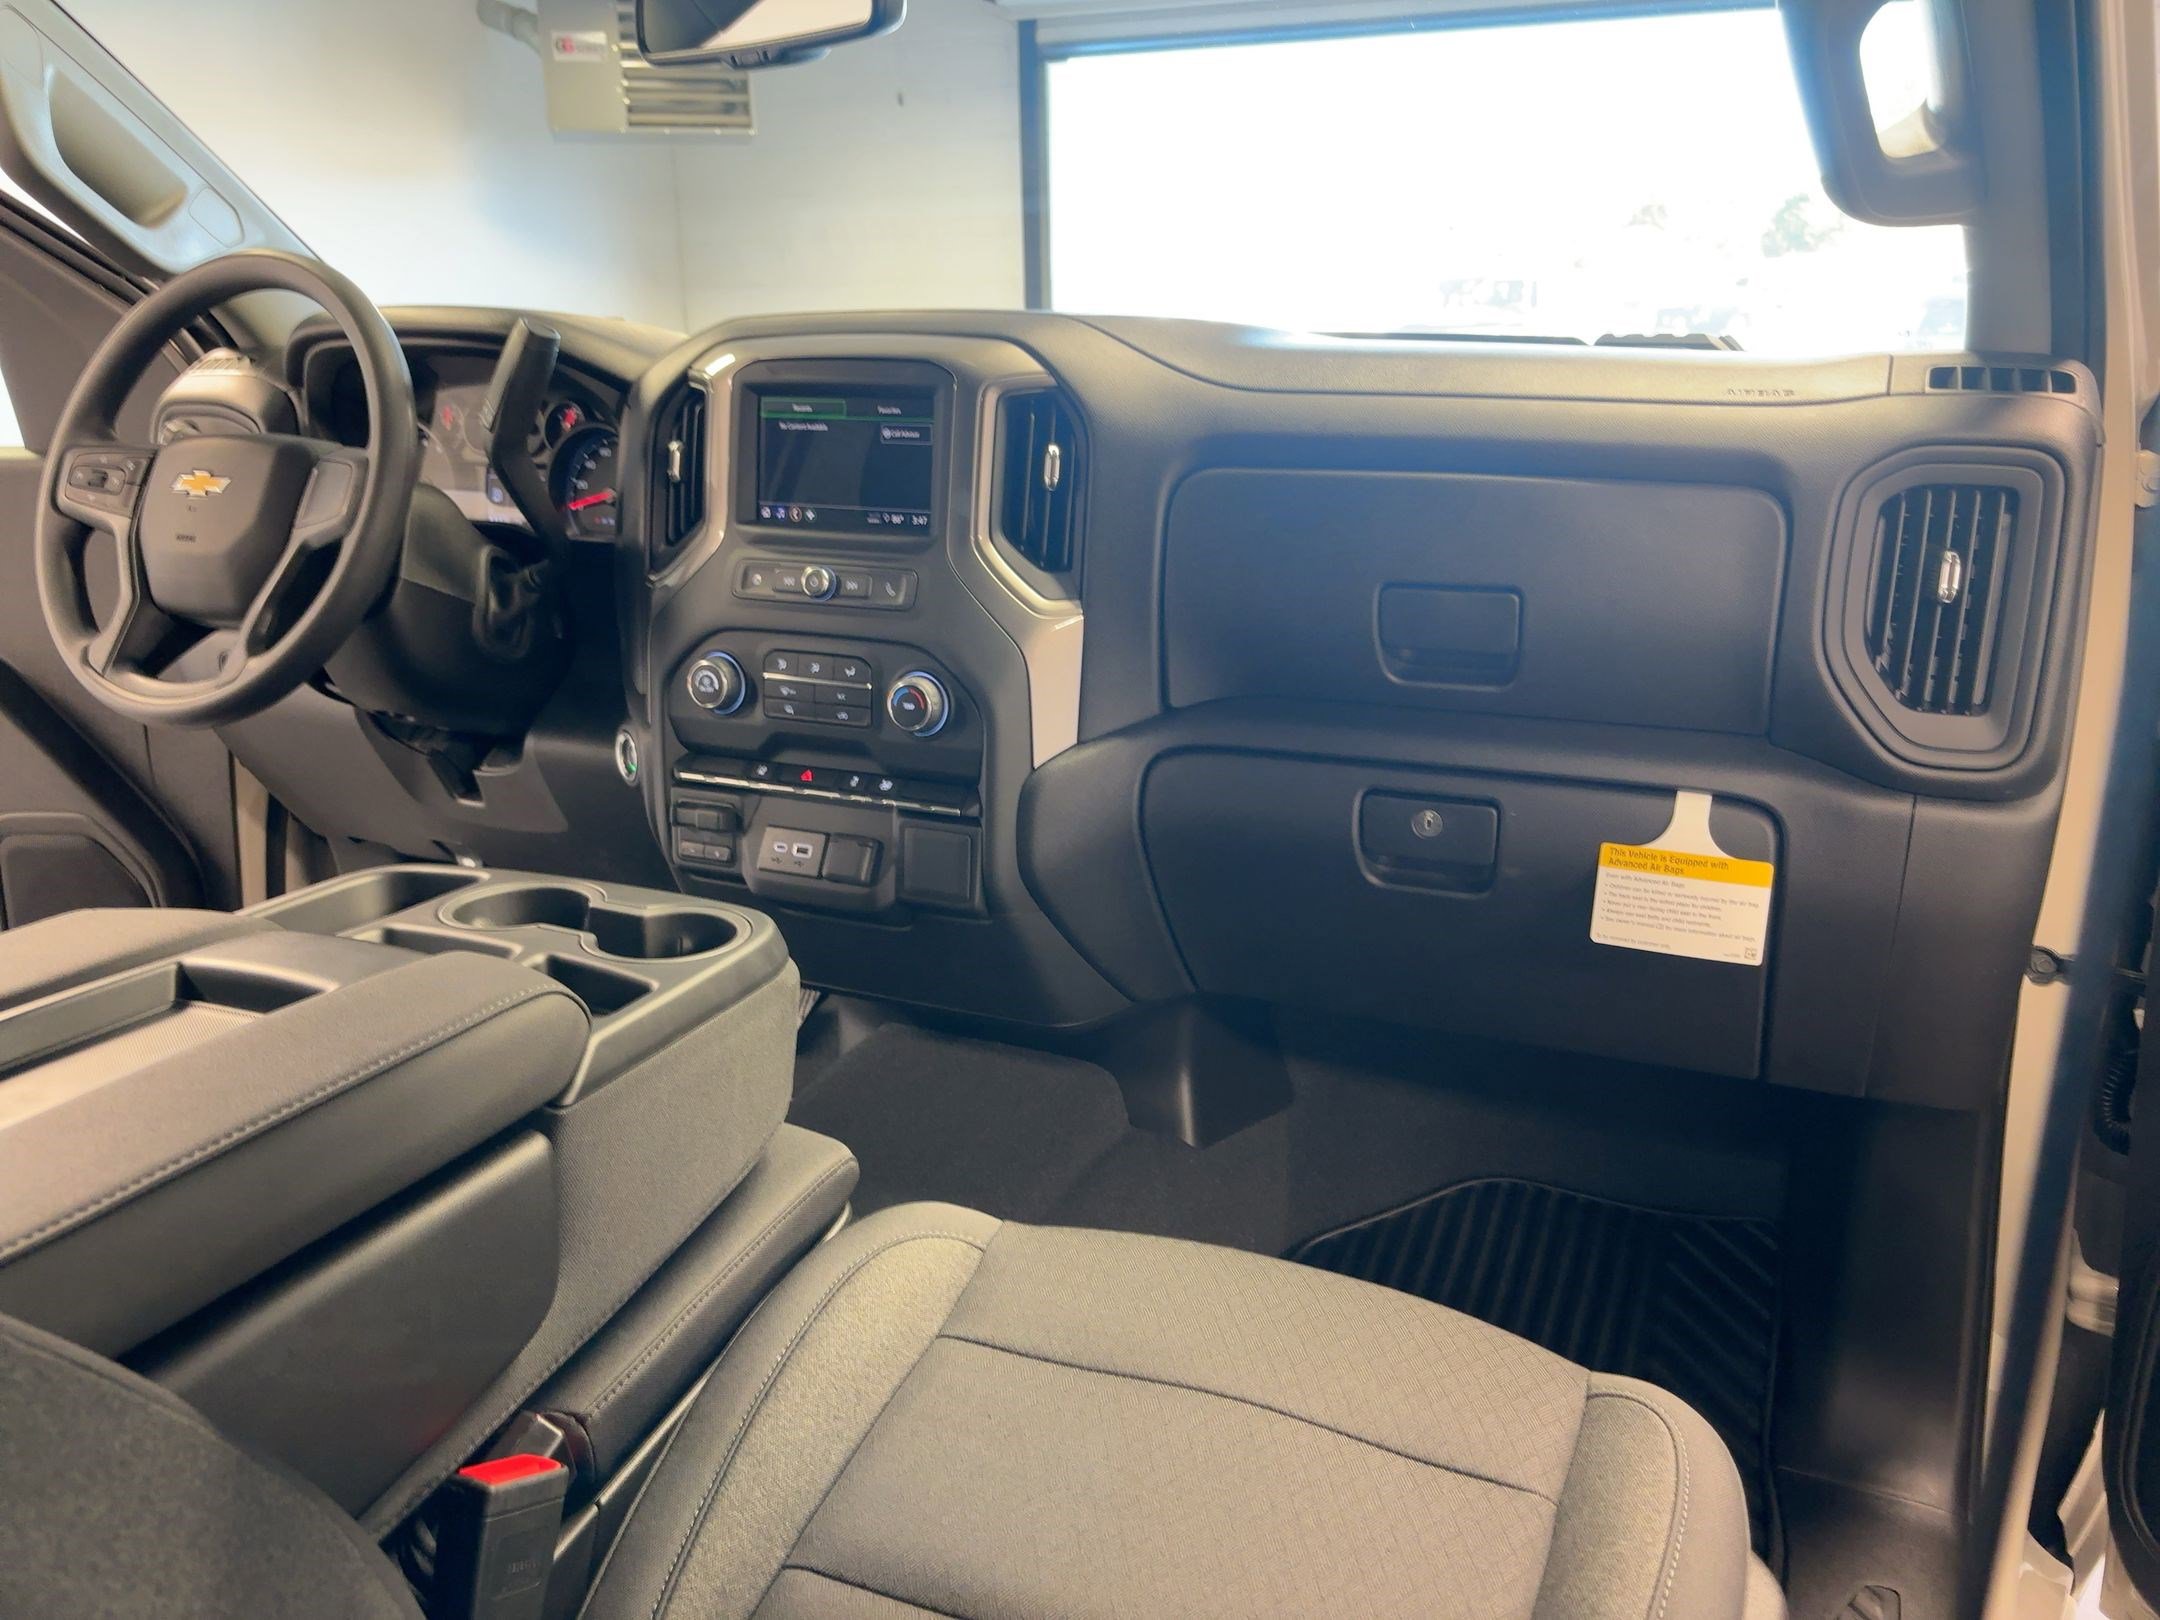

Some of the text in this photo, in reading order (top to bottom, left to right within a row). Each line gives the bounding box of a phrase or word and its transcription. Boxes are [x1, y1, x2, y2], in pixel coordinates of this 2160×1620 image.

[1608, 857, 1684, 875] Advanced Air Bags
[1609, 847, 1728, 869] This Vehicle is Equipped with
